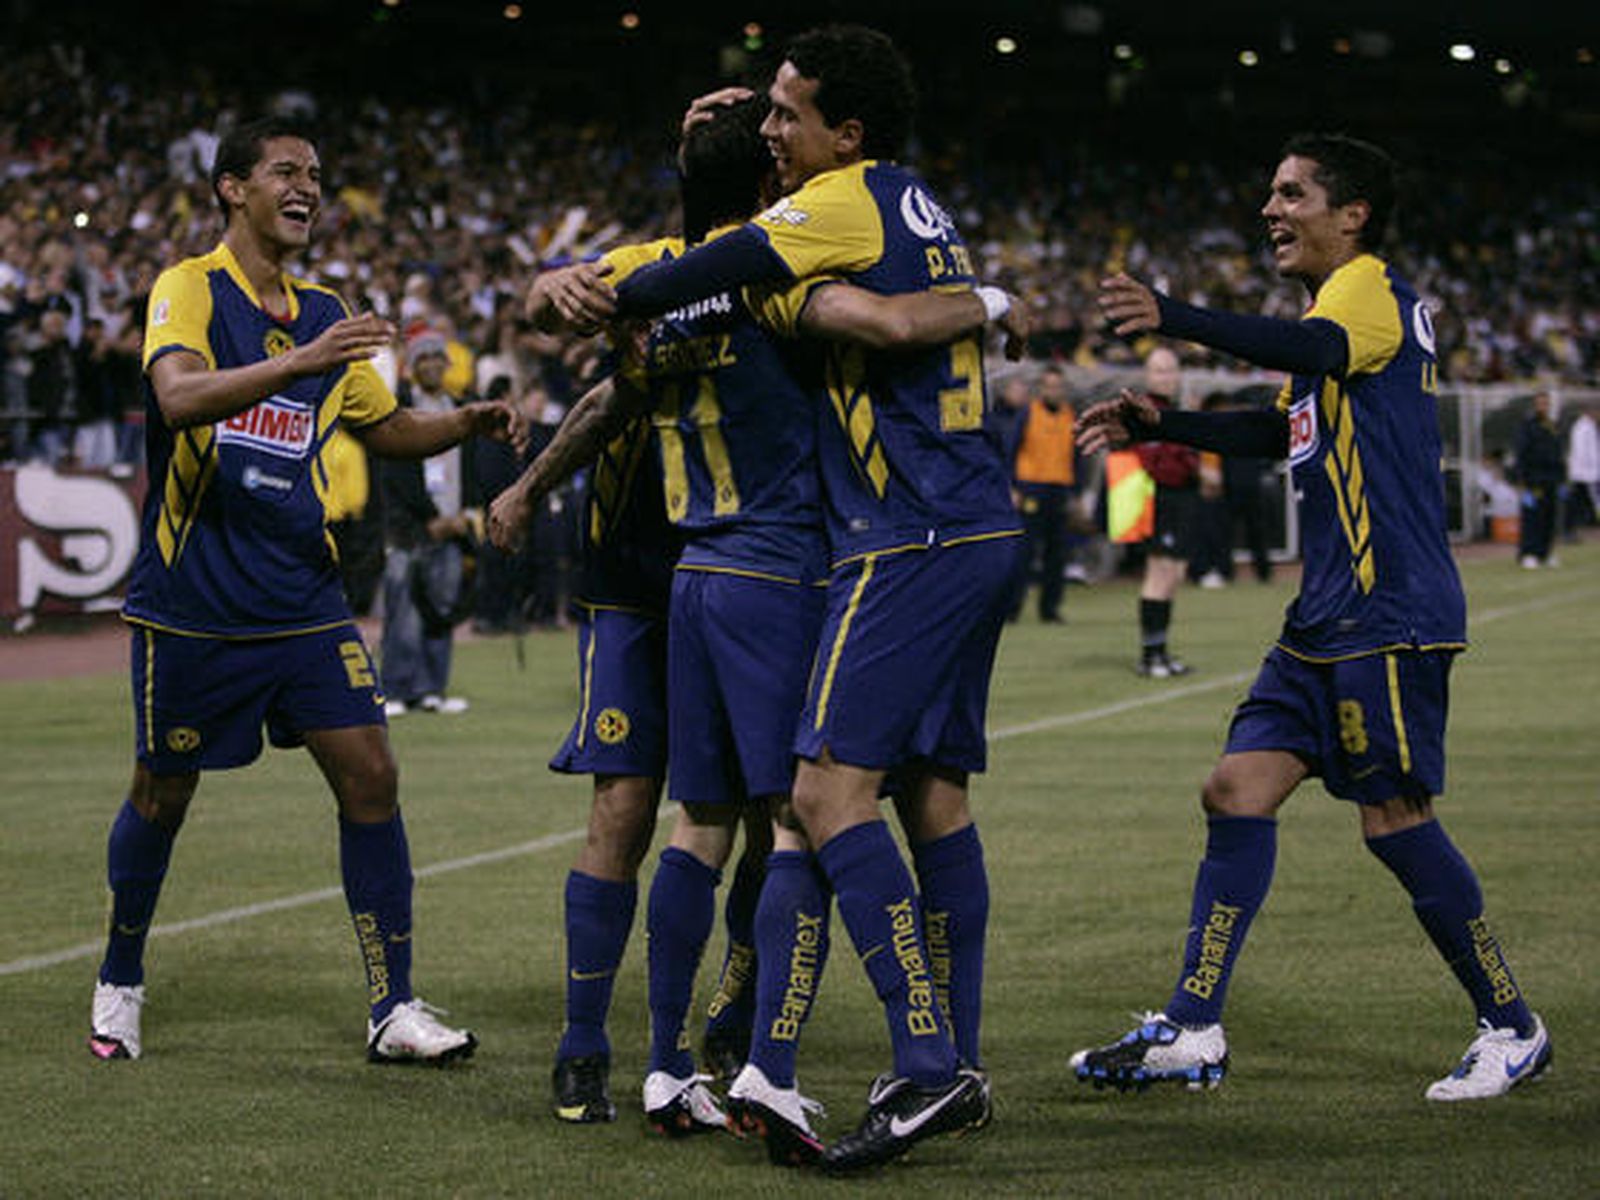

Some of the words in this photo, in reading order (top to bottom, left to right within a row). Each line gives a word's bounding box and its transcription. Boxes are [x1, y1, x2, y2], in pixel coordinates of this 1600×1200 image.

[652, 376, 741, 524] 11
[340, 641, 375, 689] 2
[771, 910, 822, 1041] Banamex
[886, 898, 938, 1035] Banamex
[1183, 901, 1243, 1000] Banamex
